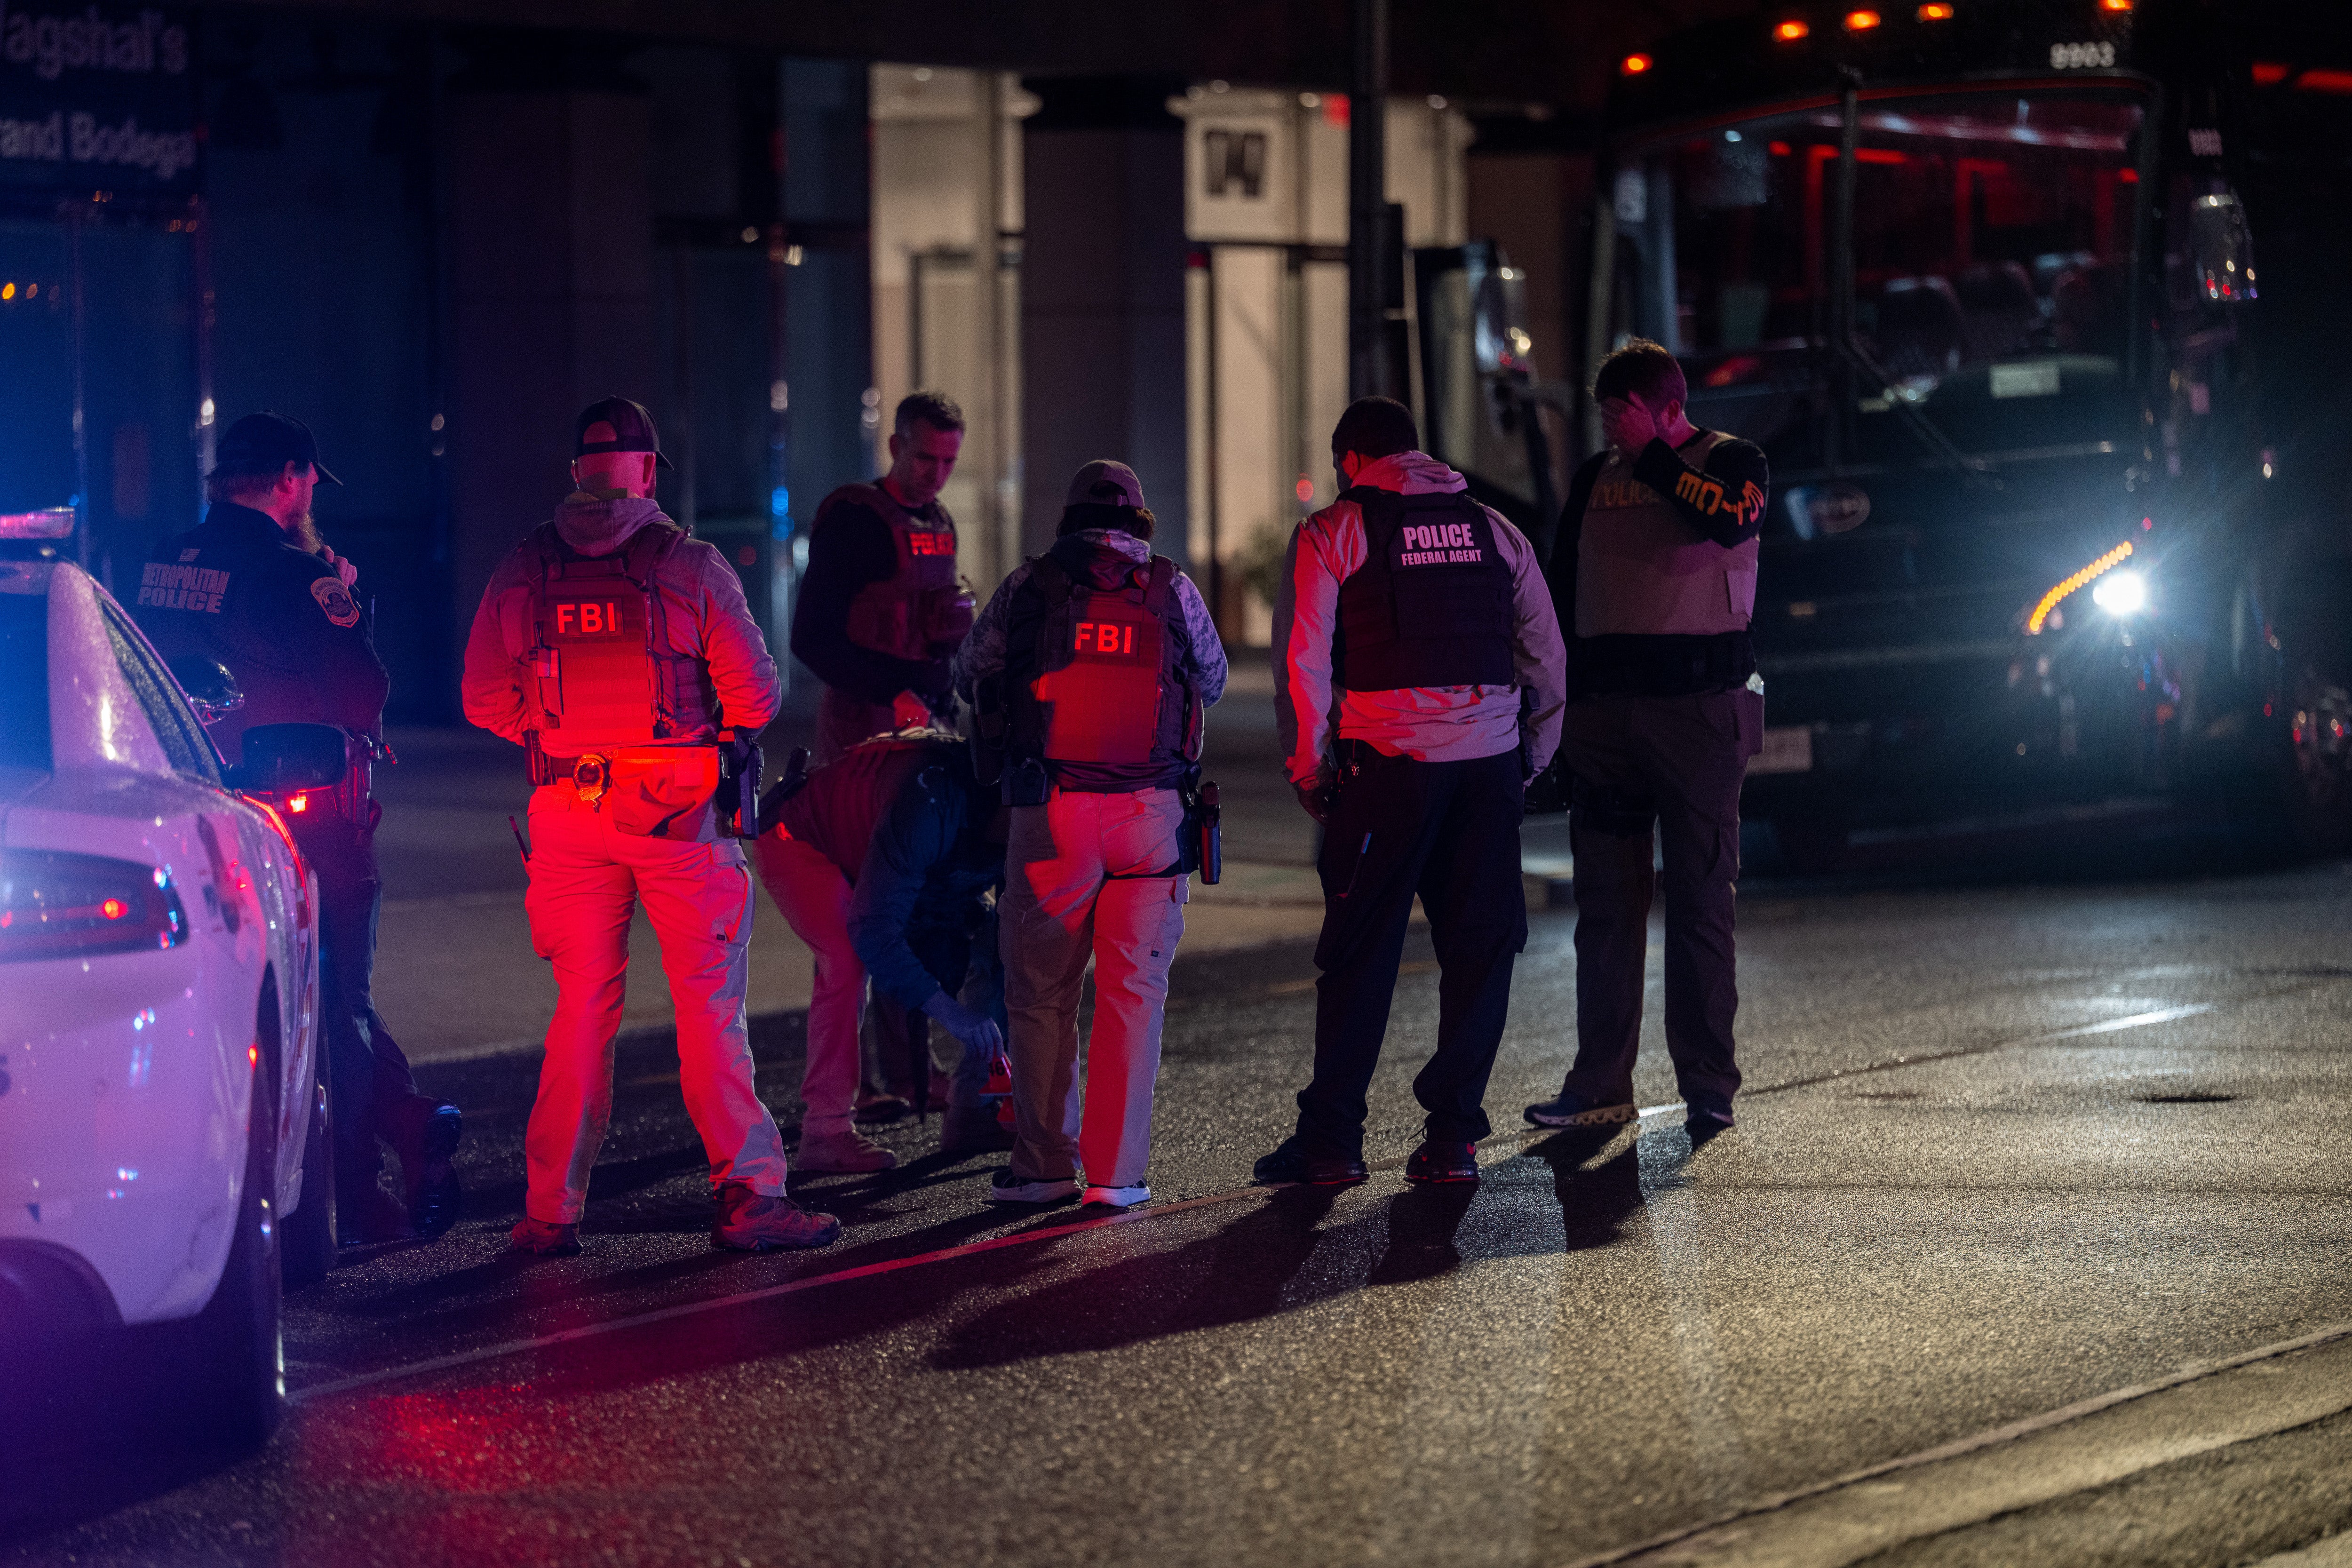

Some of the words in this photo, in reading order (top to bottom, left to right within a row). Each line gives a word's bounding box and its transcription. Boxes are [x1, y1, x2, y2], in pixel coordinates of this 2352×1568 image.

[0, 0, 188, 79] agshal's
[69, 111, 197, 180] Bodega
[1402, 524, 1474, 549] POLICE
[1401, 550, 1447, 566] FEDERAL
[1449, 549, 1482, 563] AGENT
[136, 586, 224, 614] POLICE
[557, 603, 616, 633] FBI
[1074, 623, 1132, 654] FBI
